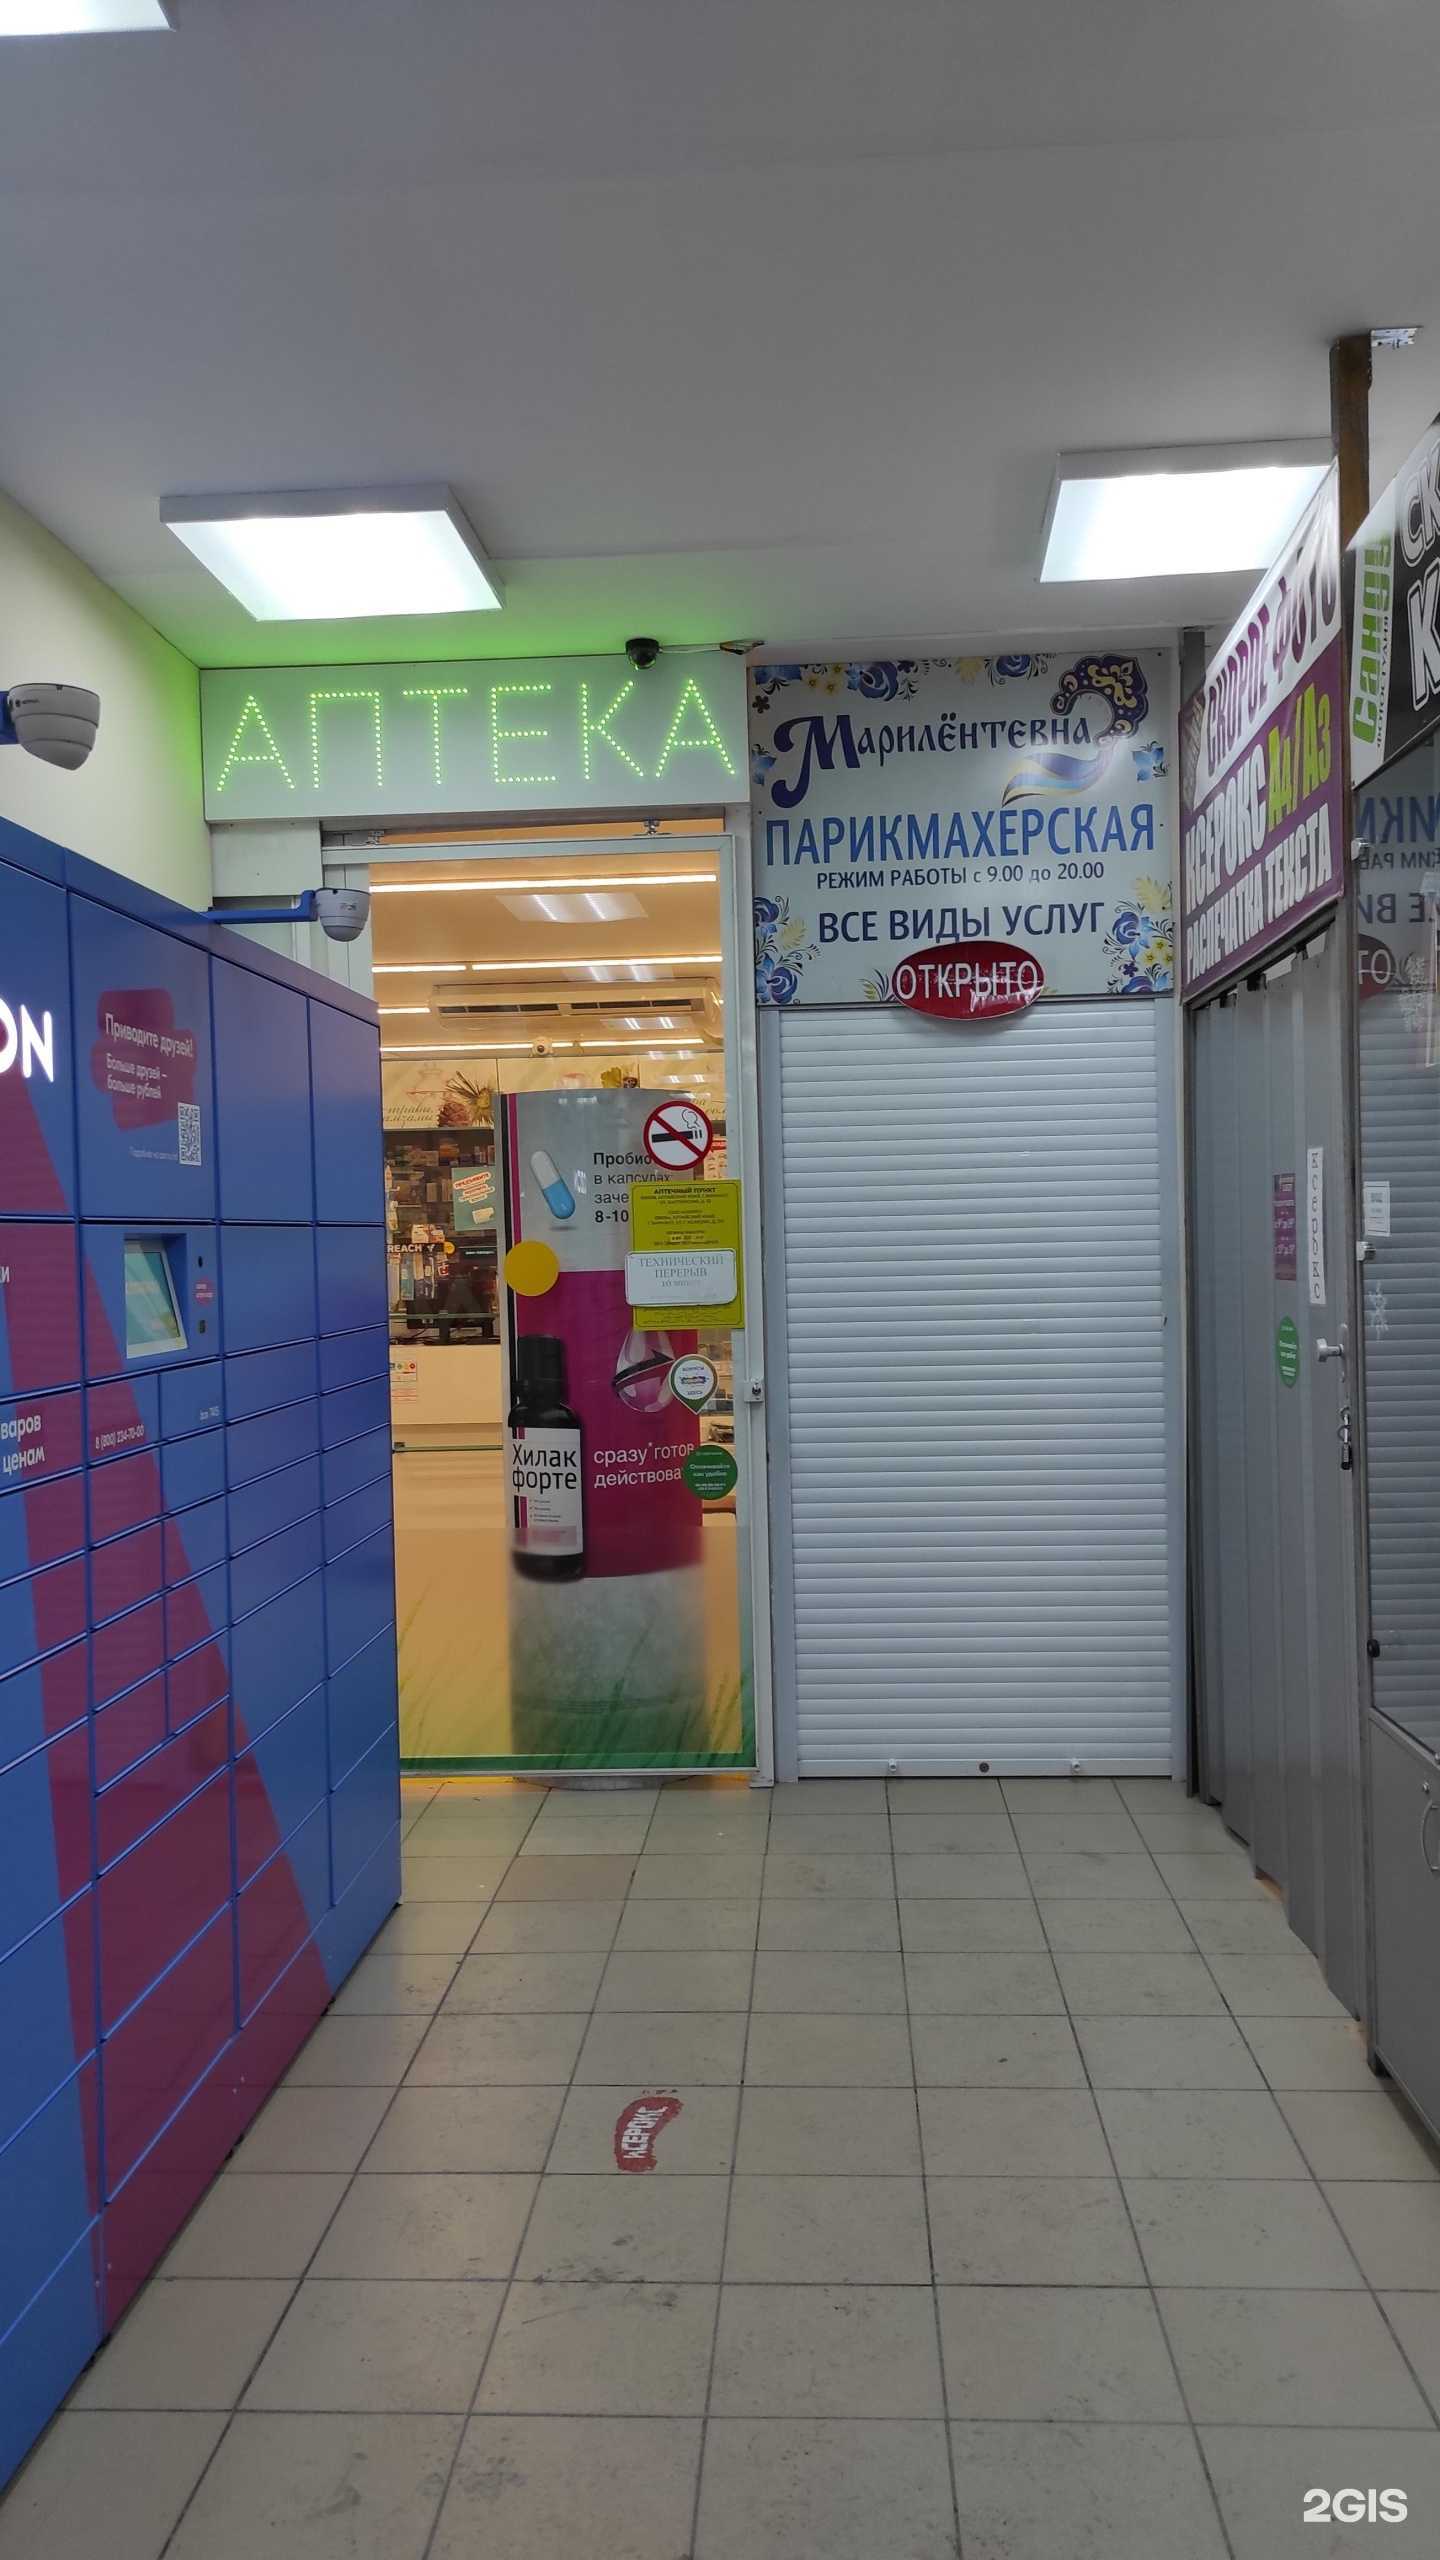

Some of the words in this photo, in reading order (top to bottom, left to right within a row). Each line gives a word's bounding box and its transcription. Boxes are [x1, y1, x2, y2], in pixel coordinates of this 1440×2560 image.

[1207, 603, 1269, 777] СКОРОЕ
[1273, 490, 1337, 684] ФОТО
[216, 676, 736, 792] АПТЕКА
[771, 713, 1092, 808] Марилёнтевна
[1186, 743, 1267, 916] КСЕРОКС
[1268, 681, 1331, 832] А4/А3
[765, 804, 1155, 866] ПАРИКМАХЕРСКАЯ
[817, 869, 886, 889] РЕЖИМ
[891, 867, 967, 887] РАБОТЫ
[973, 870, 982, 883] с
[987, 865, 1024, 884] 9.00
[1028, 867, 1051, 884] до
[1057, 861, 1105, 881] 20.00
[1187, 862, 1264, 984] РАСПЕЧАТКА
[1264, 803, 1332, 924] ТЕКСТА
[818, 911, 877, 943] ВСЕ
[889, 905, 989, 942] ВИДЫ
[1003, 903, 1105, 936] УСЛУГ
[896, 961, 1040, 1000] ОТКРЫТО
[105, 1012, 159, 1049] Приводите
[159, 1034, 193, 1058] друзей!
[106, 1053, 136, 1076] Больше
[136, 1063, 161, 1080] друзей
[107, 1074, 136, 1095] больше
[136, 1081, 162, 1100] рублей
[593, 1152, 652, 1168] Пробио
[594, 1175, 603, 1185] в
[608, 1174, 672, 1185] капсулах
[594, 1193, 629, 1204] заче
[594, 1210, 630, 1223] 8-10
[388, 1243, 422, 1253] REACH
[639, 1255, 724, 1268] ТЕХНИЧЕСКИЙ
[655, 1267, 708, 1279] ПЕРЕРЫВ
[2, 1446, 45, 1476] ценам
[512, 1443, 577, 1467] Хилак
[512, 1466, 577, 1495] форте
[594, 1467, 682, 1489] действова
